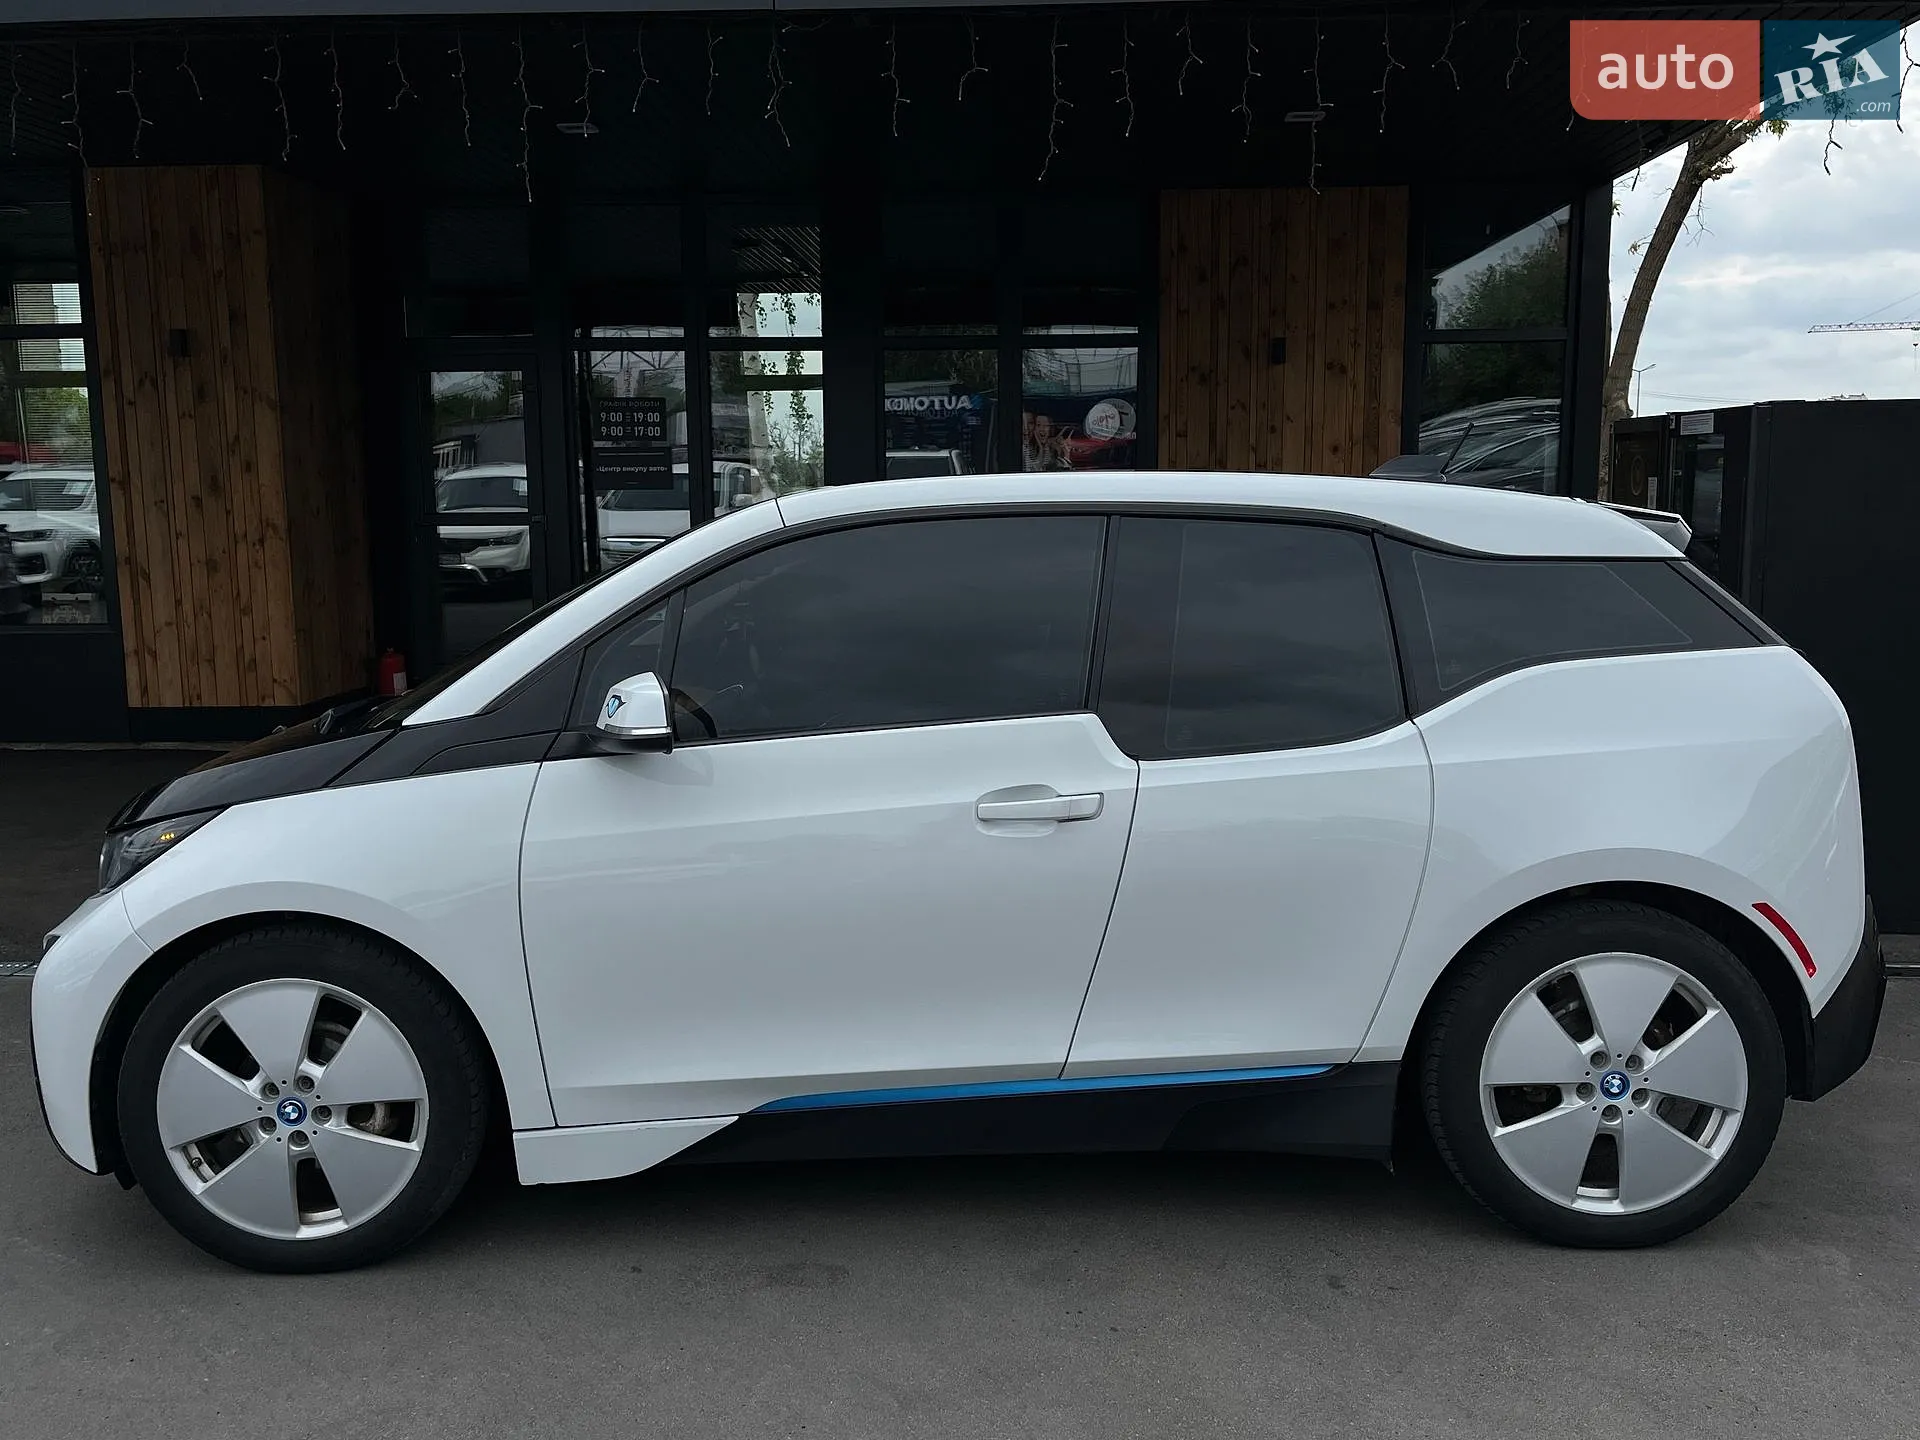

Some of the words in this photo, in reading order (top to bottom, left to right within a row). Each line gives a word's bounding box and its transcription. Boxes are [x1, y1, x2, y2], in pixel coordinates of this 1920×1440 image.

[600, 412, 623, 422] 9:00
[633, 412, 660, 422] 19:00
[601, 426, 623, 436] 9:00
[634, 426, 661, 436] 17:00
